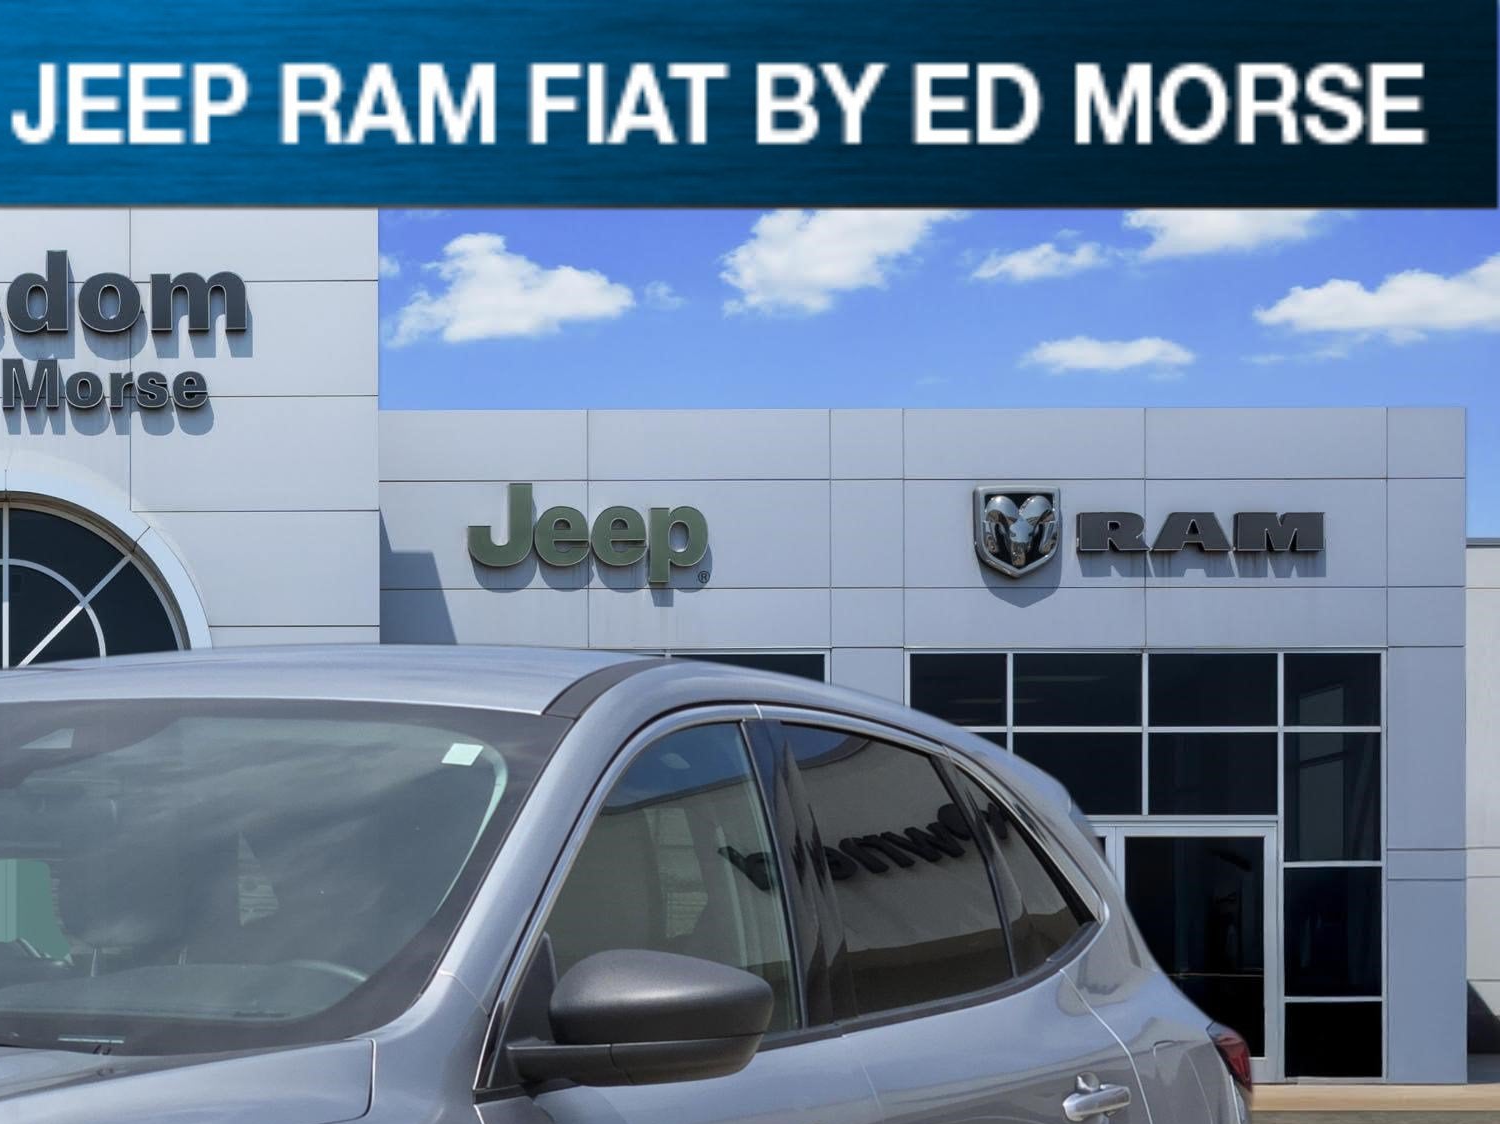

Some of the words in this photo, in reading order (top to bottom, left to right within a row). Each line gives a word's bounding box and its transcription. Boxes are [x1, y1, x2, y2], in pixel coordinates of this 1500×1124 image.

[2, 358, 209, 409] Morse
[467, 483, 709, 583] Jeep
[1076, 511, 1325, 552] RAM
